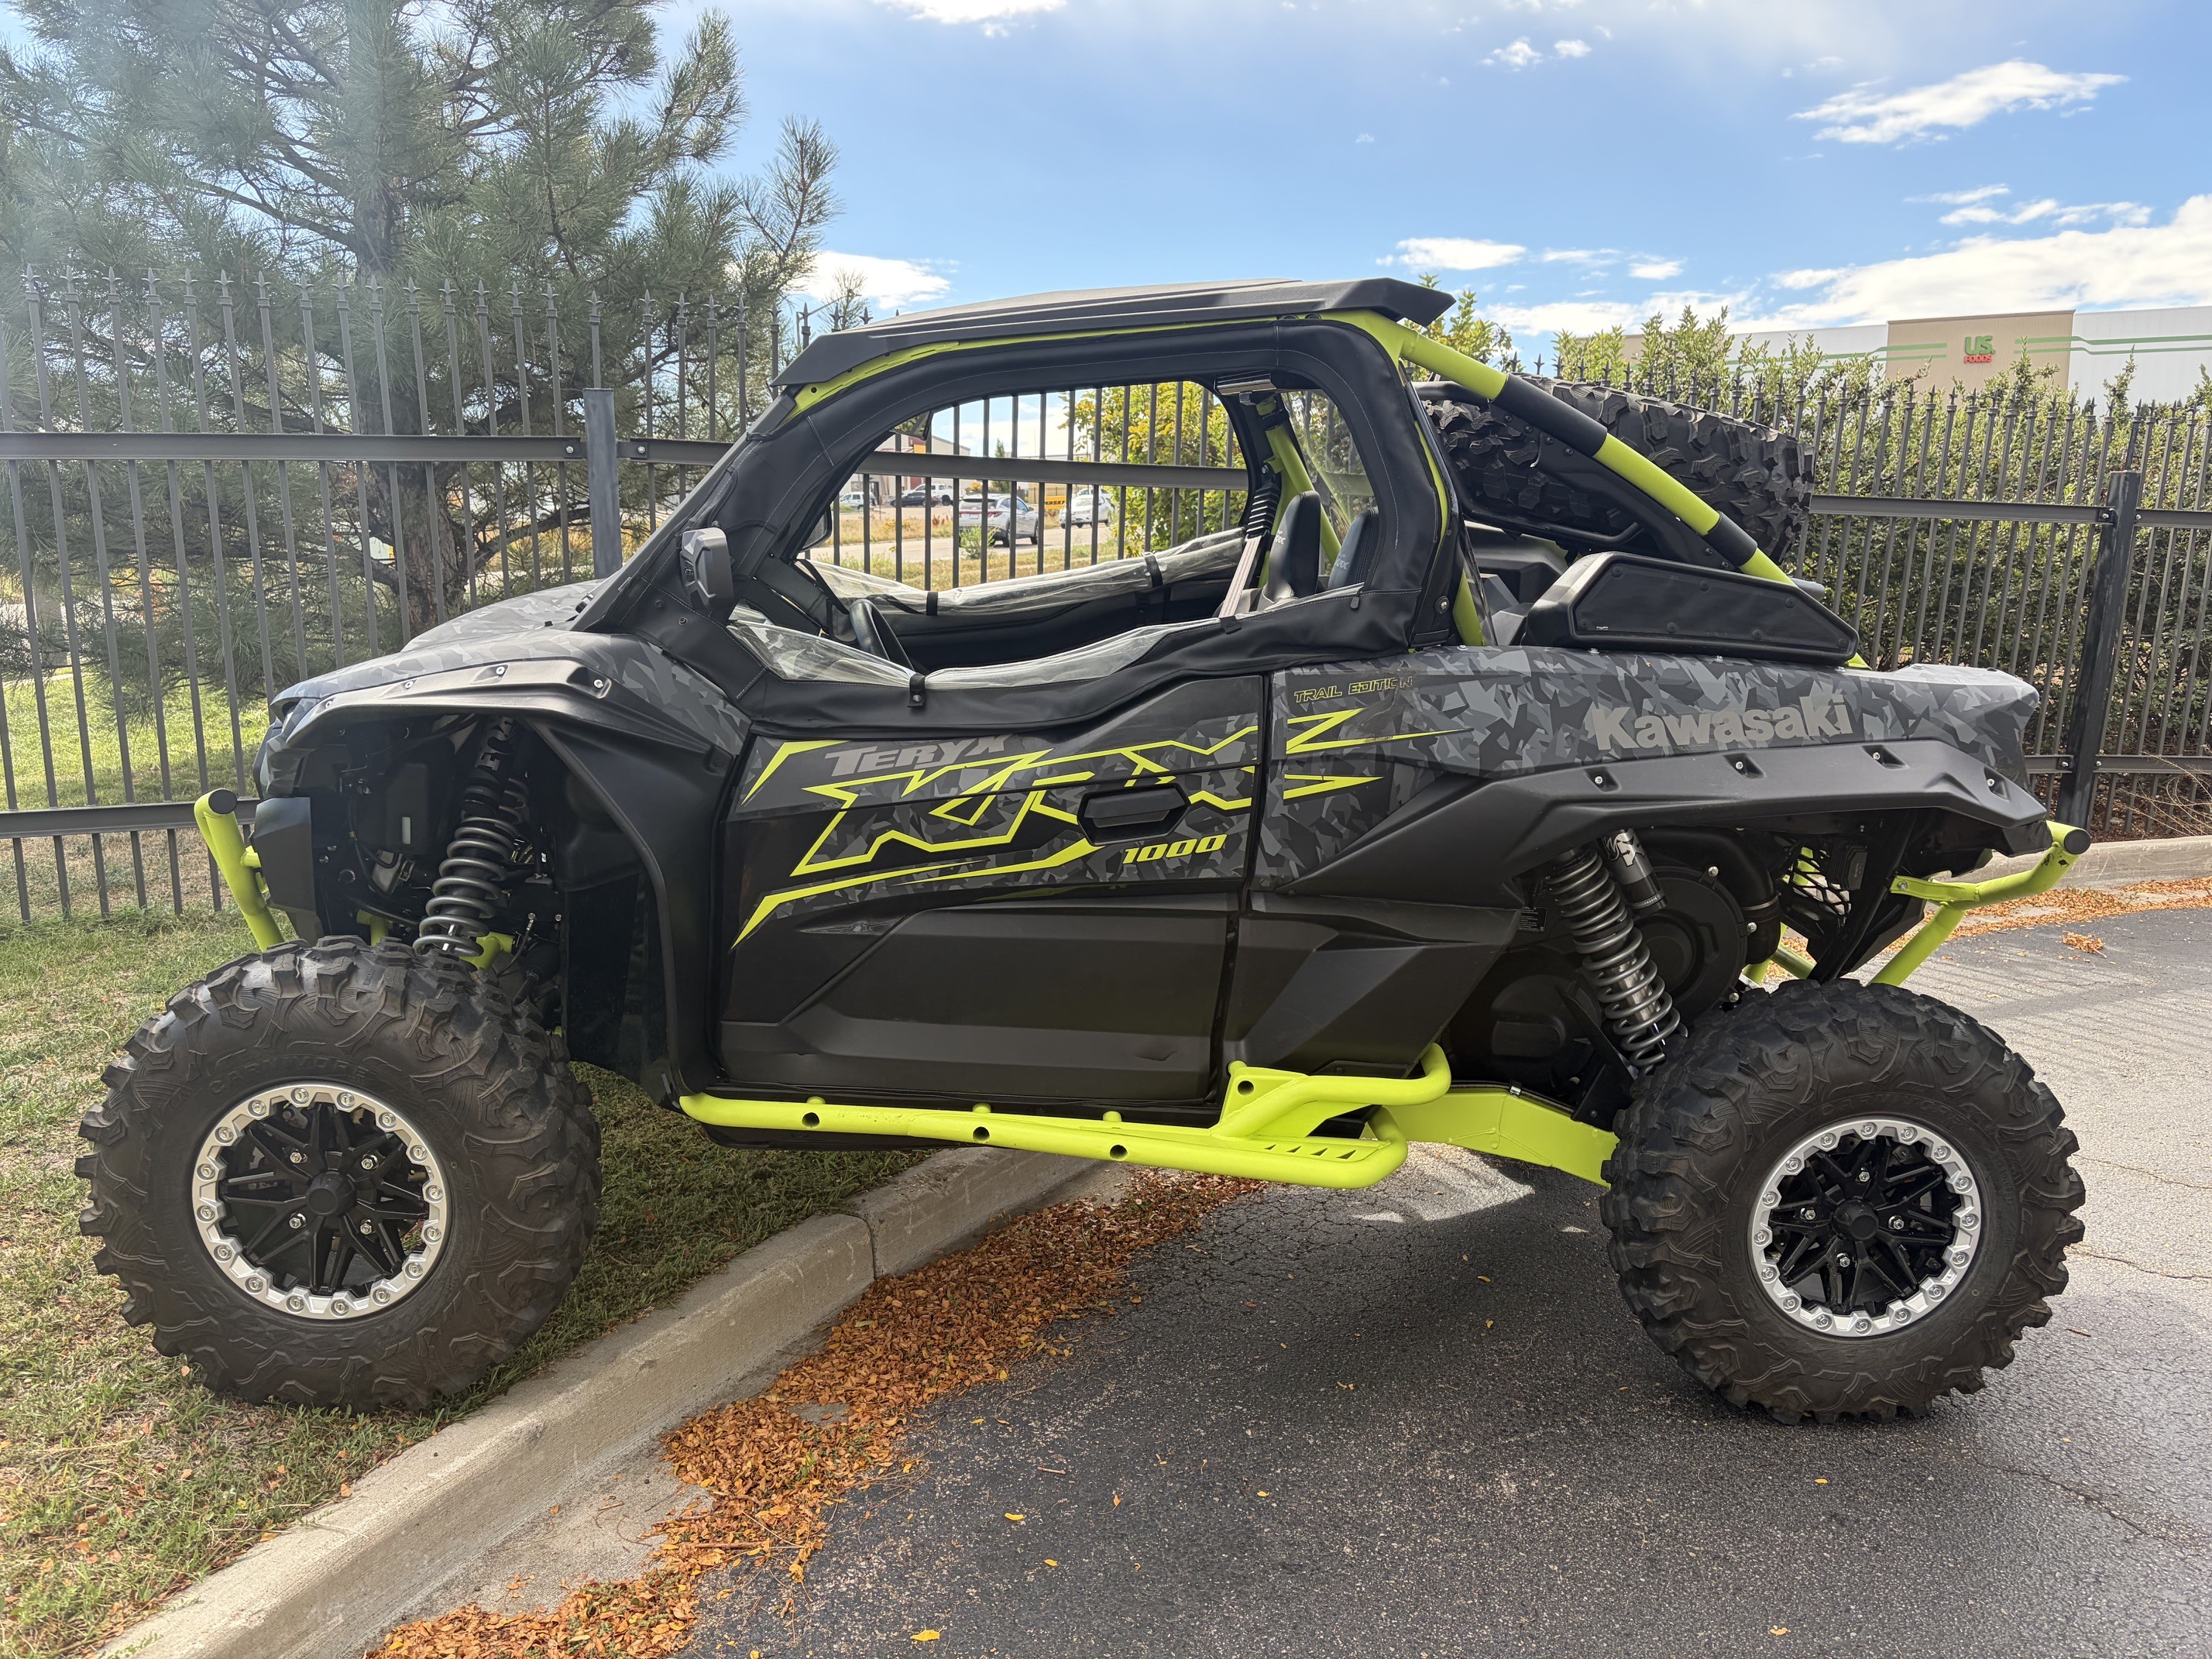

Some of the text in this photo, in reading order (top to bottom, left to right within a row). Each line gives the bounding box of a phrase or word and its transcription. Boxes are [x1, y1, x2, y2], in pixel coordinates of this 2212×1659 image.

[1963, 355, 1992, 364] FOODS
[1294, 676, 1413, 702] TRAIL EDITION
[1591, 688, 1853, 750] Kawasaki
[825, 733, 1013, 776] TERYX
[1122, 833, 1228, 864] 1000
